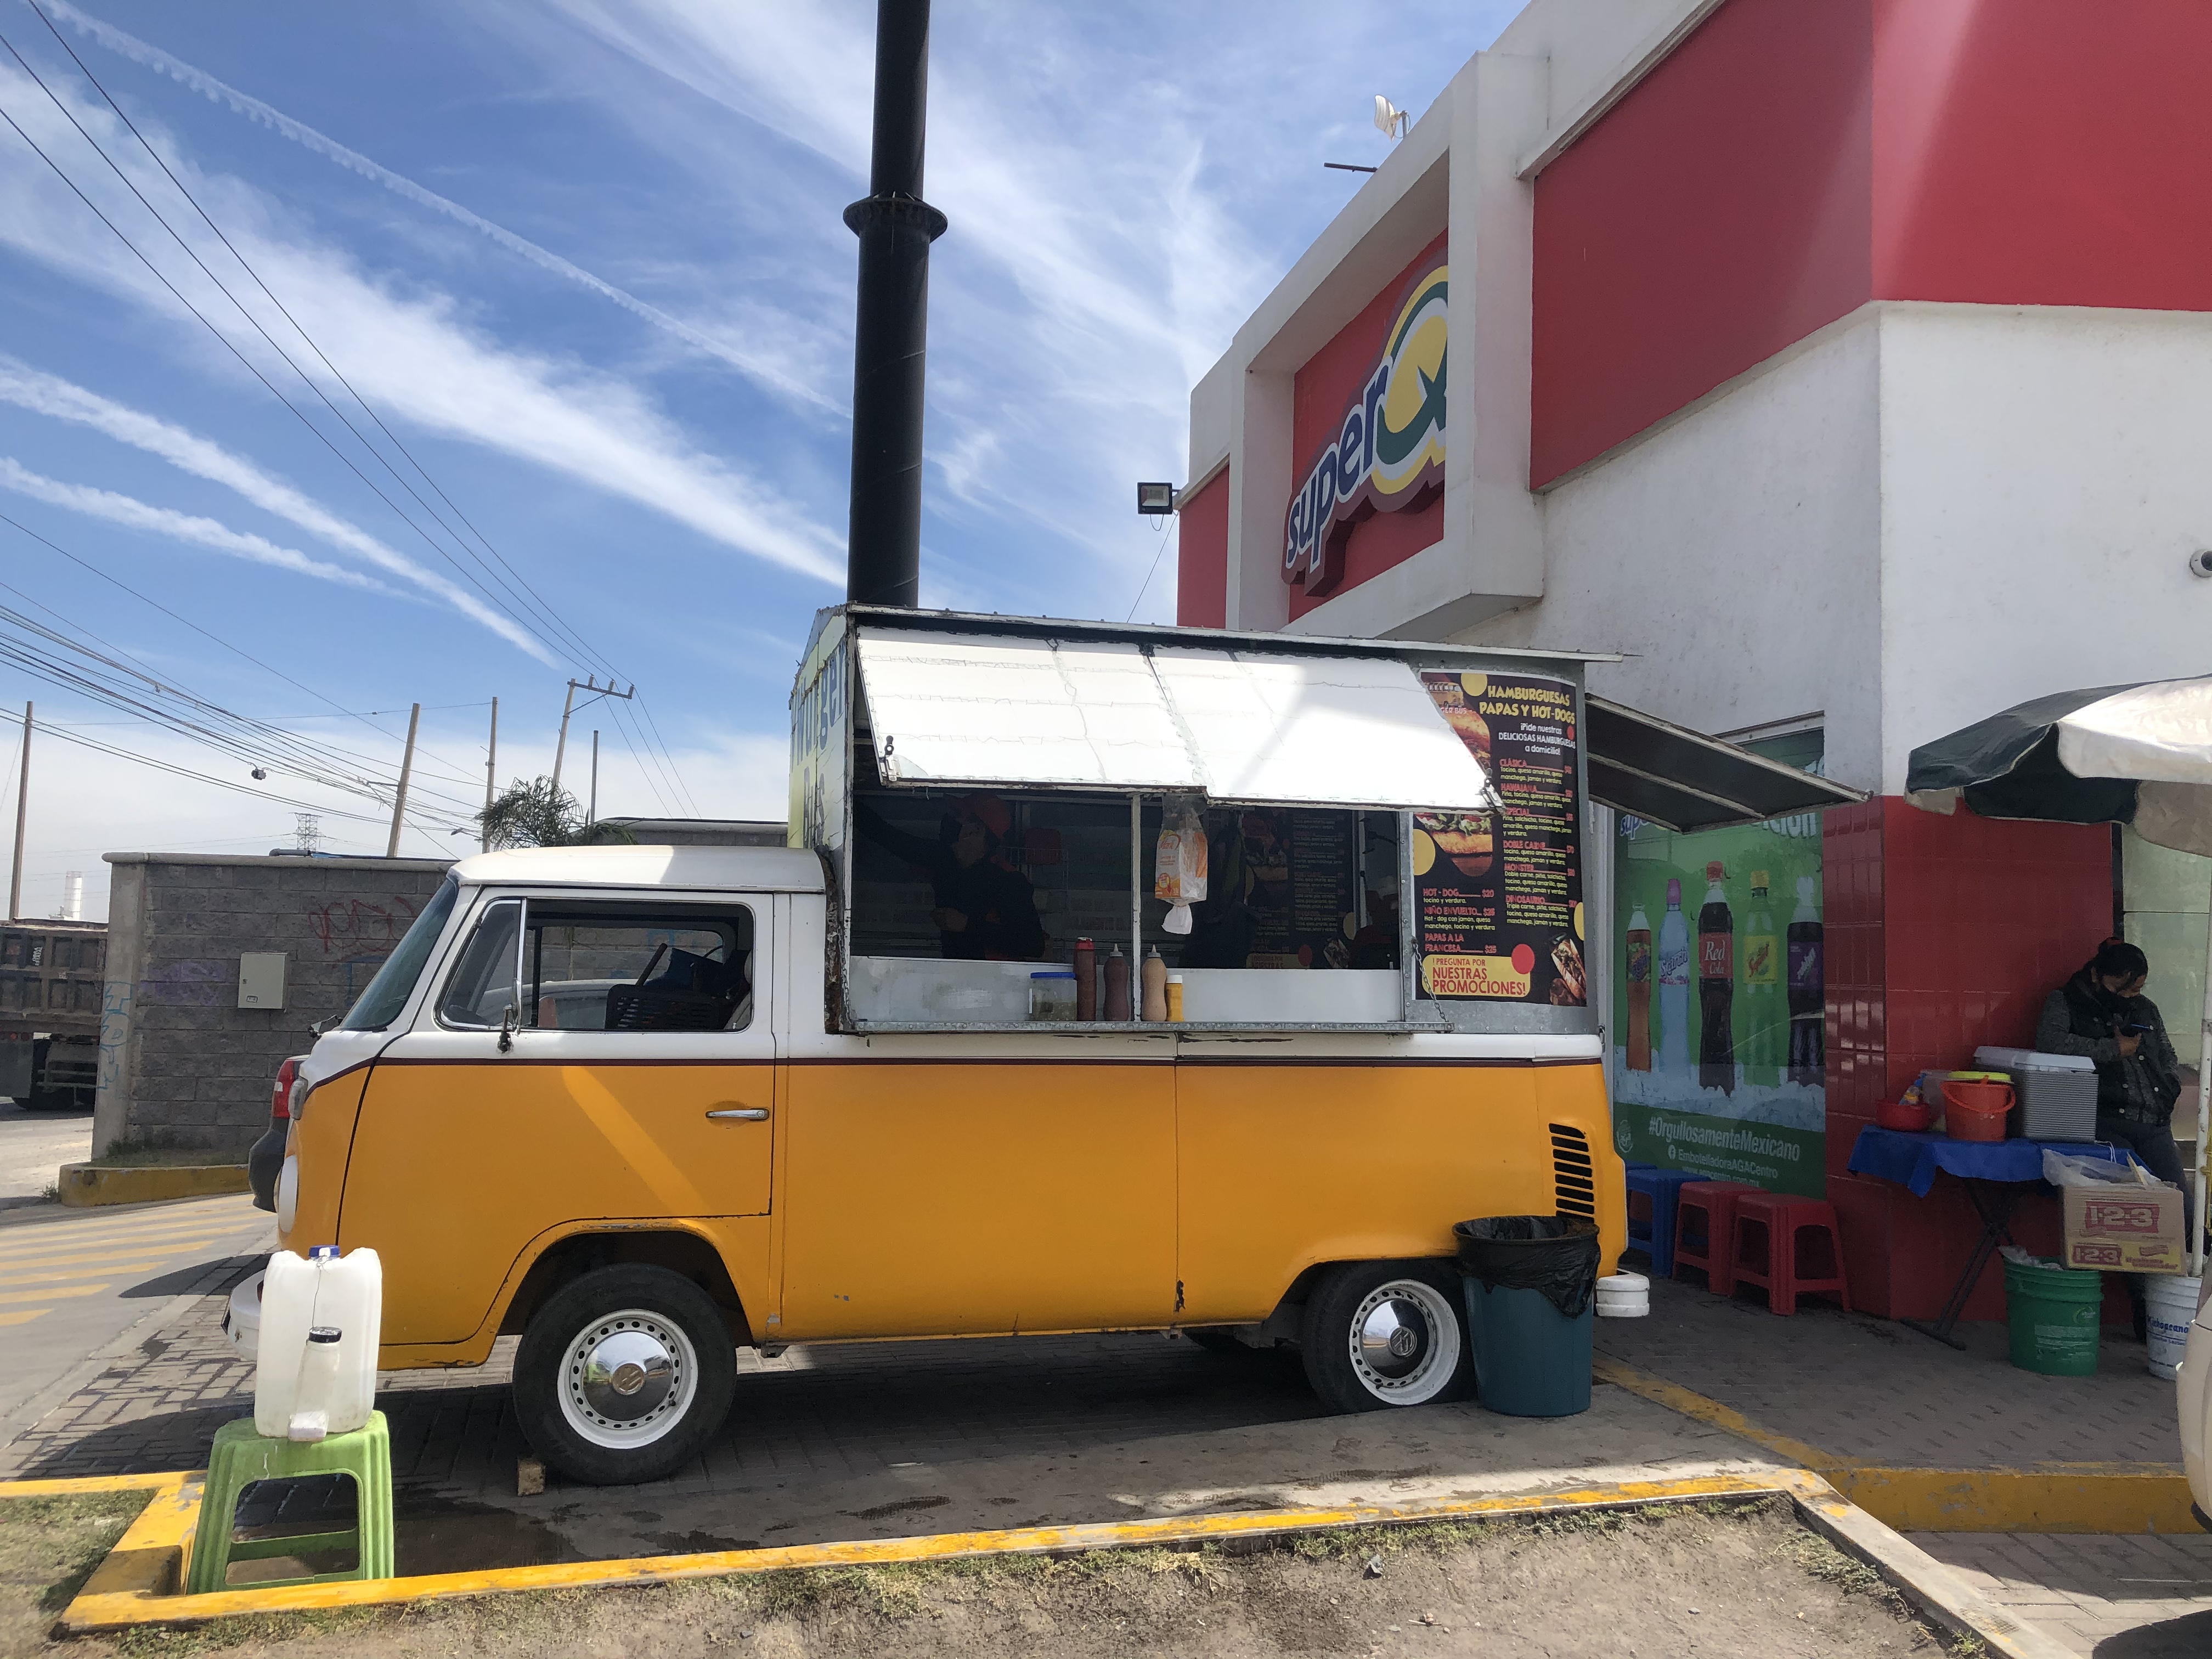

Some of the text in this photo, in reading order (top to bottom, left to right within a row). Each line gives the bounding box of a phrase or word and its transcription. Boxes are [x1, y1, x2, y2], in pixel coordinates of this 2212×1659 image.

[1285, 354, 1393, 574] super
[1488, 686, 1570, 706] HAMBURGUESAS
[1480, 702, 1575, 724] PAPAS Y HOT-DOGS
[1538, 725, 1562, 735] nuestras
[1499, 732, 1576, 749] DELICIOSAS HAMBURGUESAS
[1505, 807, 1530, 816] SPECIAL
[1503, 840, 1523, 848] DOBLE
[1423, 888, 1437, 896] HOT
[1442, 888, 1459, 897] DOG
[1424, 905, 1442, 914] NIÑO
[1443, 907, 1477, 915] ENVUELTO
[1448, 933, 1454, 941] A
[1455, 933, 1464, 941] LA
[1425, 944, 1461, 952] FRANCESA
[1705, 941, 1726, 961] Red
[1433, 967, 1487, 980] NUESTRAS
[1709, 962, 1725, 975] Cola
[1432, 979, 1526, 995] PROMOCIONES!
[1649, 1116, 1801, 1161] #OrgullosamenteMexicano
[1678, 1149, 1779, 1178] EmbotelladoraAGACentro
